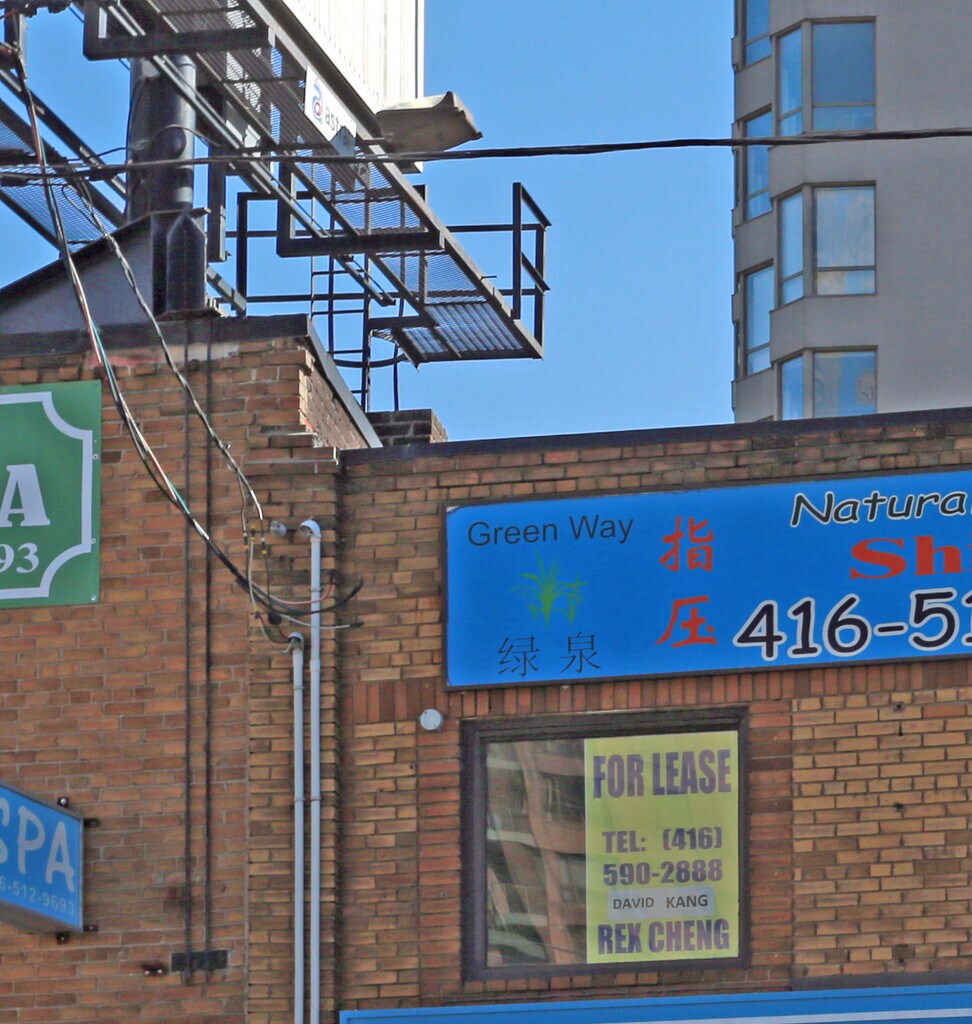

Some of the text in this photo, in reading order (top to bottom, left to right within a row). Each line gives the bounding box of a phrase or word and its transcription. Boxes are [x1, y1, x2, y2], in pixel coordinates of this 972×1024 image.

[468, 514, 633, 546] Green Way
[498, 631, 601, 677] 绿泉
[593, 749, 732, 798] FOR LEASE
[602, 826, 723, 853] TEL: (416)
[603, 859, 723, 886] 590-2888
[613, 894, 708, 909] DAVID KANG
[597, 918, 730, 954] REX CHENG
